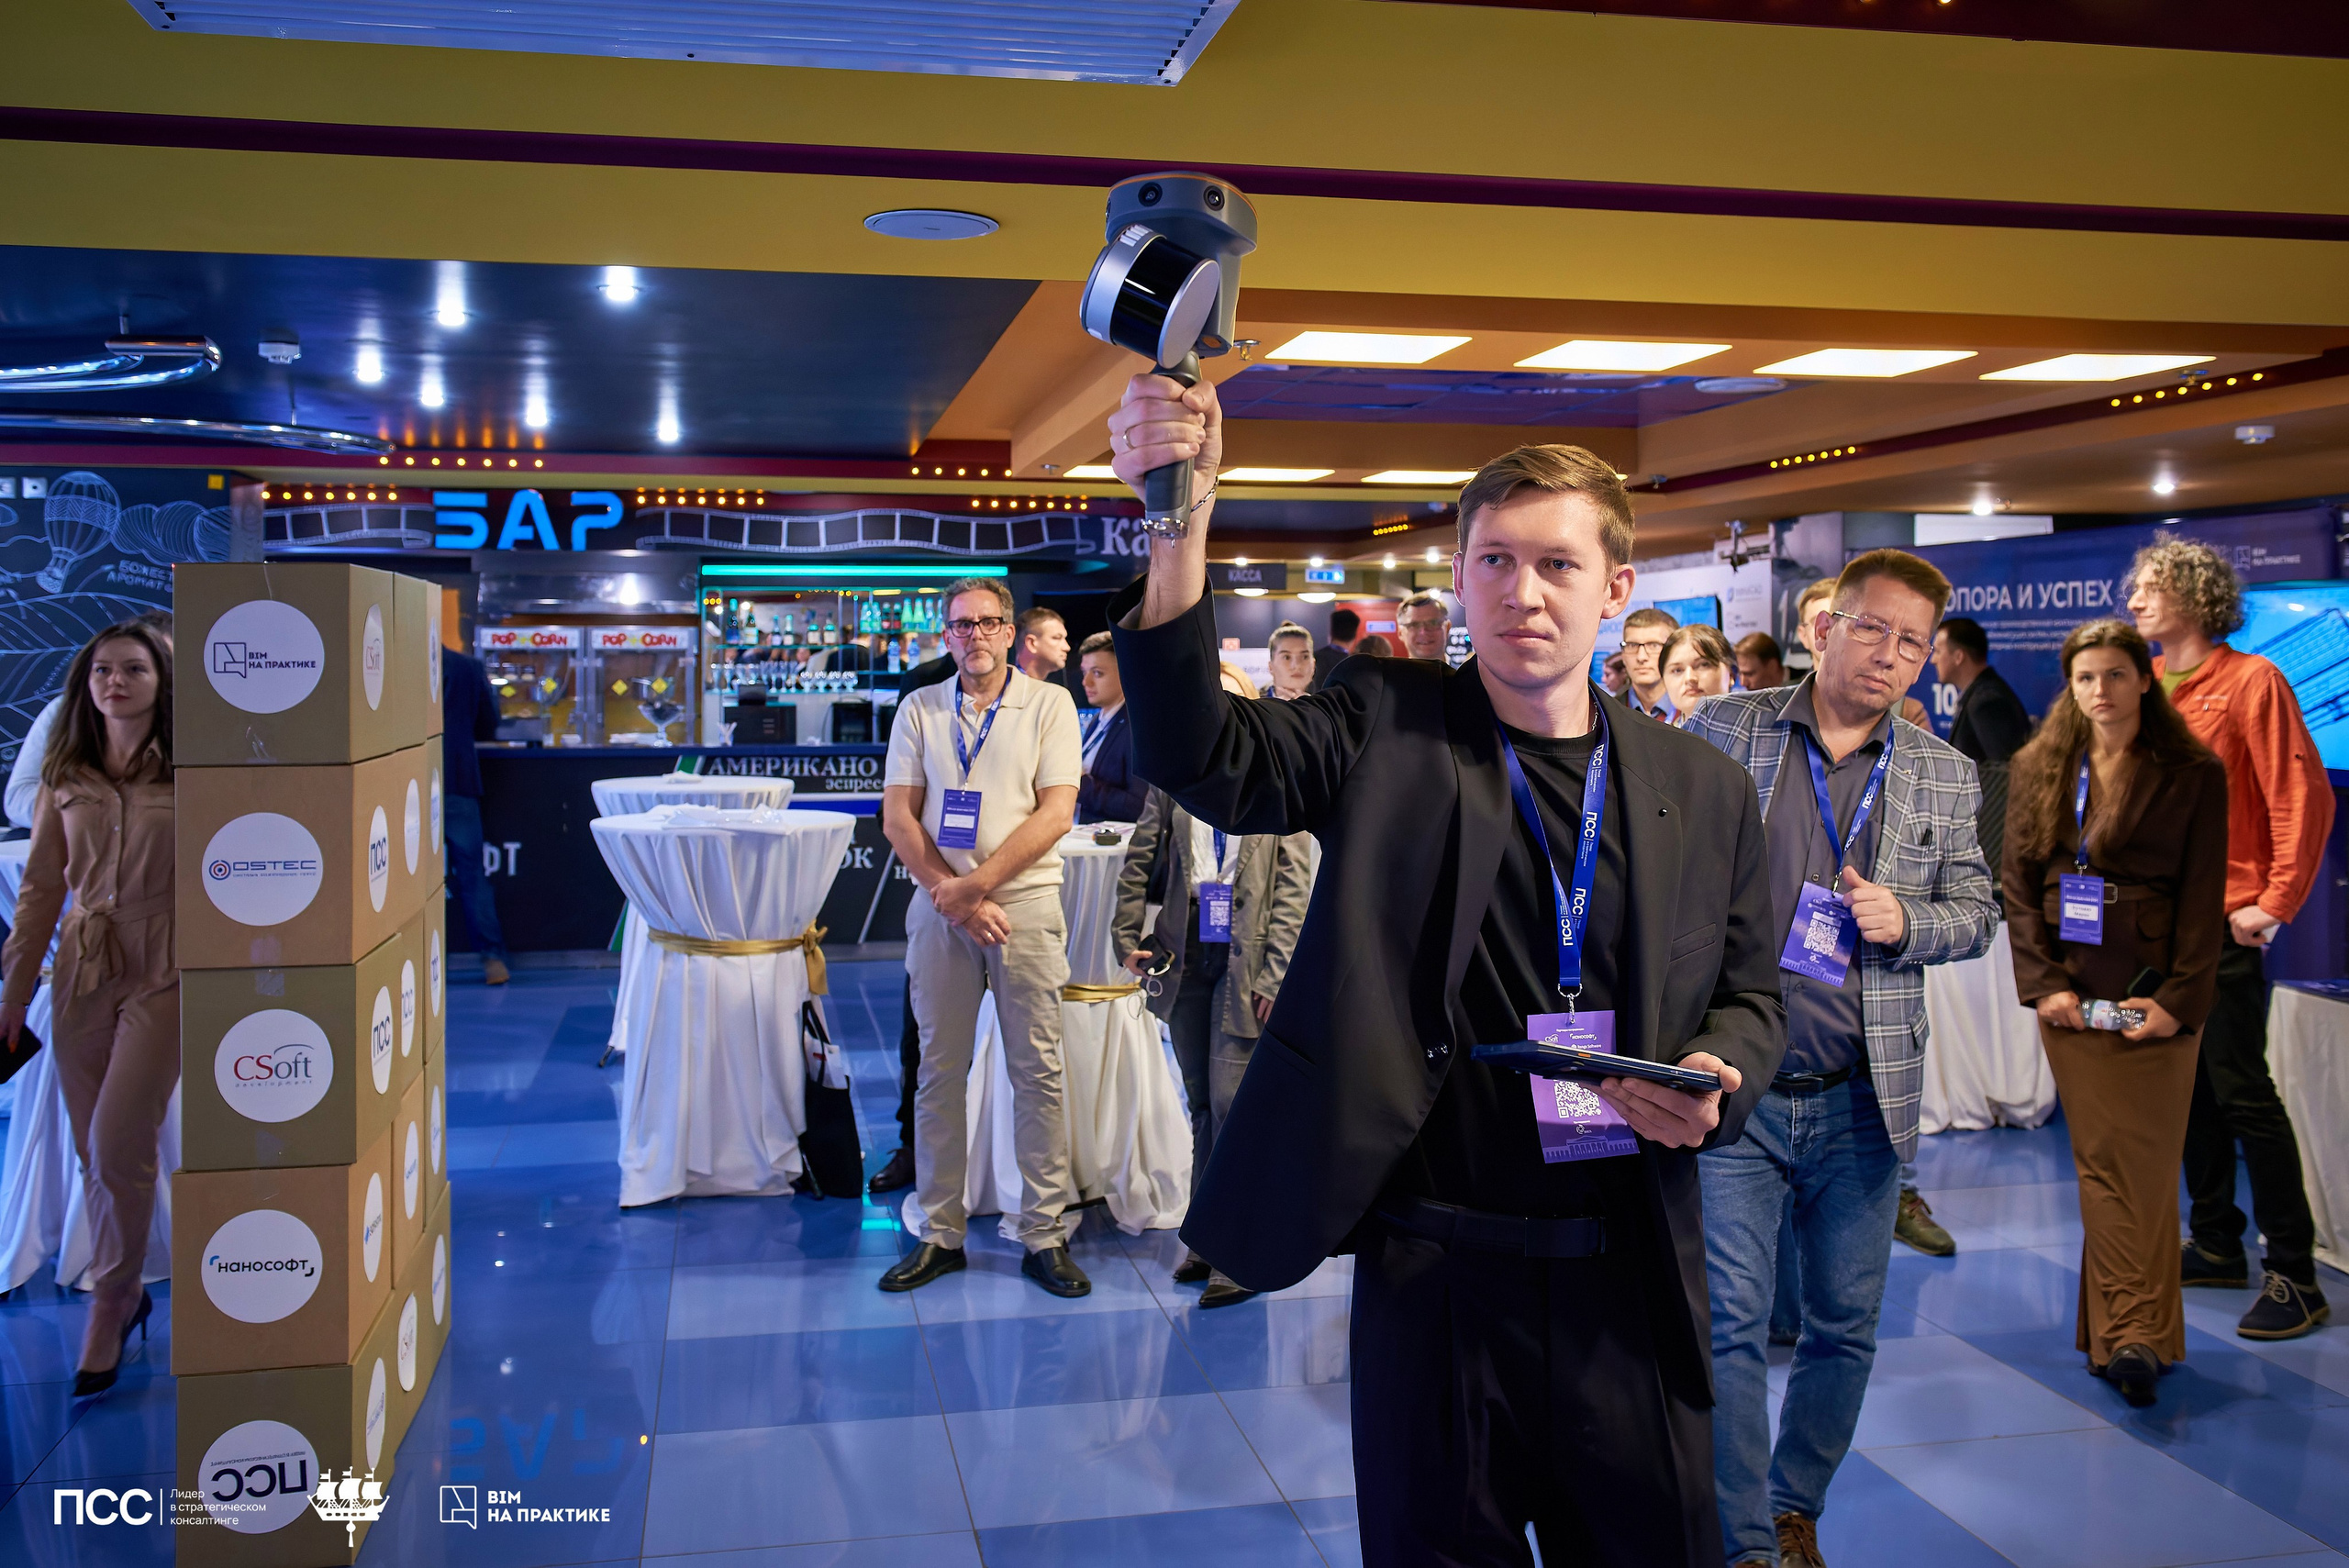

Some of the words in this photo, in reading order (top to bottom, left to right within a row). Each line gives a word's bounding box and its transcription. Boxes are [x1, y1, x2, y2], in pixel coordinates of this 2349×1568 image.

[433, 489, 624, 551] БАР
[1228, 569, 1263, 583] КАССА
[2019, 584, 2032, 609] И
[2038, 580, 2114, 609] УСПЕХ
[249, 661, 262, 669] НА
[264, 661, 316, 669] ПРАКТИКЕ
[708, 756, 878, 777] АМЕРИКАНО
[1592, 743, 1605, 767] ПСС
[1584, 811, 1598, 838] ПСС
[233, 861, 317, 871] OSTEC
[371, 837, 386, 875] ПСС
[1572, 887, 1586, 916] ПСС
[1561, 918, 1574, 946] ПСС
[373, 1016, 390, 1058] ПСС
[233, 1052, 312, 1081] CSoft
[211, 1460, 307, 1502] ПСС
